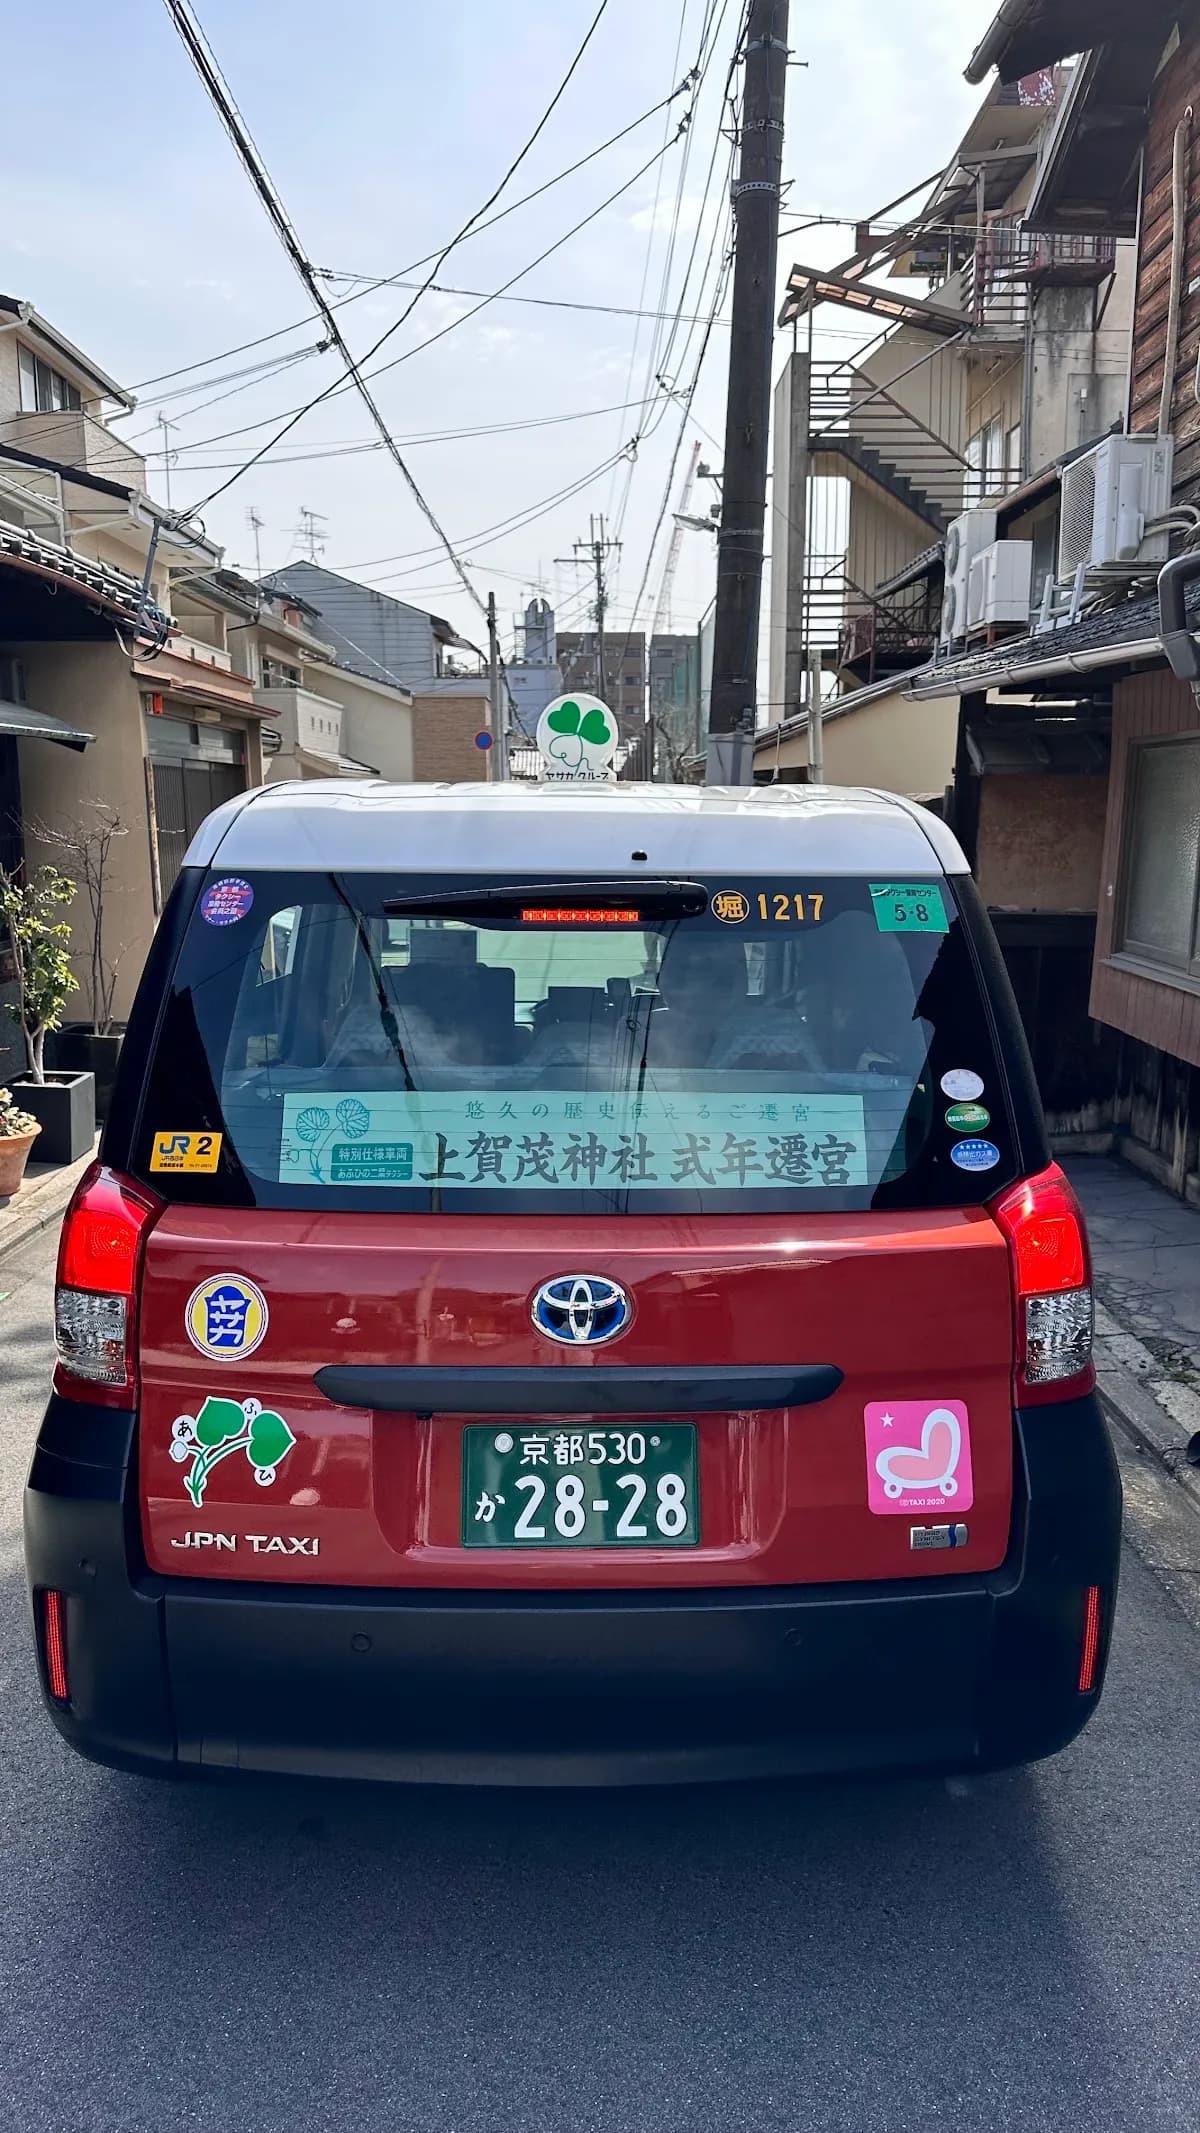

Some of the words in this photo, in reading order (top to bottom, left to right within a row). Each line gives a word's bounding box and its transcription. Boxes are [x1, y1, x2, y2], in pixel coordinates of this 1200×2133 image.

[716, 896, 744, 918] 堀
[757, 894, 824, 921] 1217
[159, 1135, 191, 1154] JR
[196, 1136, 213, 1155] 2
[338, 1147, 408, 1161] 特別仕様車両
[419, 1131, 658, 1186] 上賀茂神社
[670, 1132, 857, 1186] 式年遷宮
[209, 1294, 246, 1345] ヤサカ
[244, 1402, 258, 1415] ふ
[177, 1421, 193, 1437] あ
[259, 1469, 272, 1481] ひ
[474, 1491, 506, 1523] か
[514, 1473, 688, 1538] 28-28
[171, 1531, 237, 1552] JPN
[244, 1535, 320, 1556] TAXI
